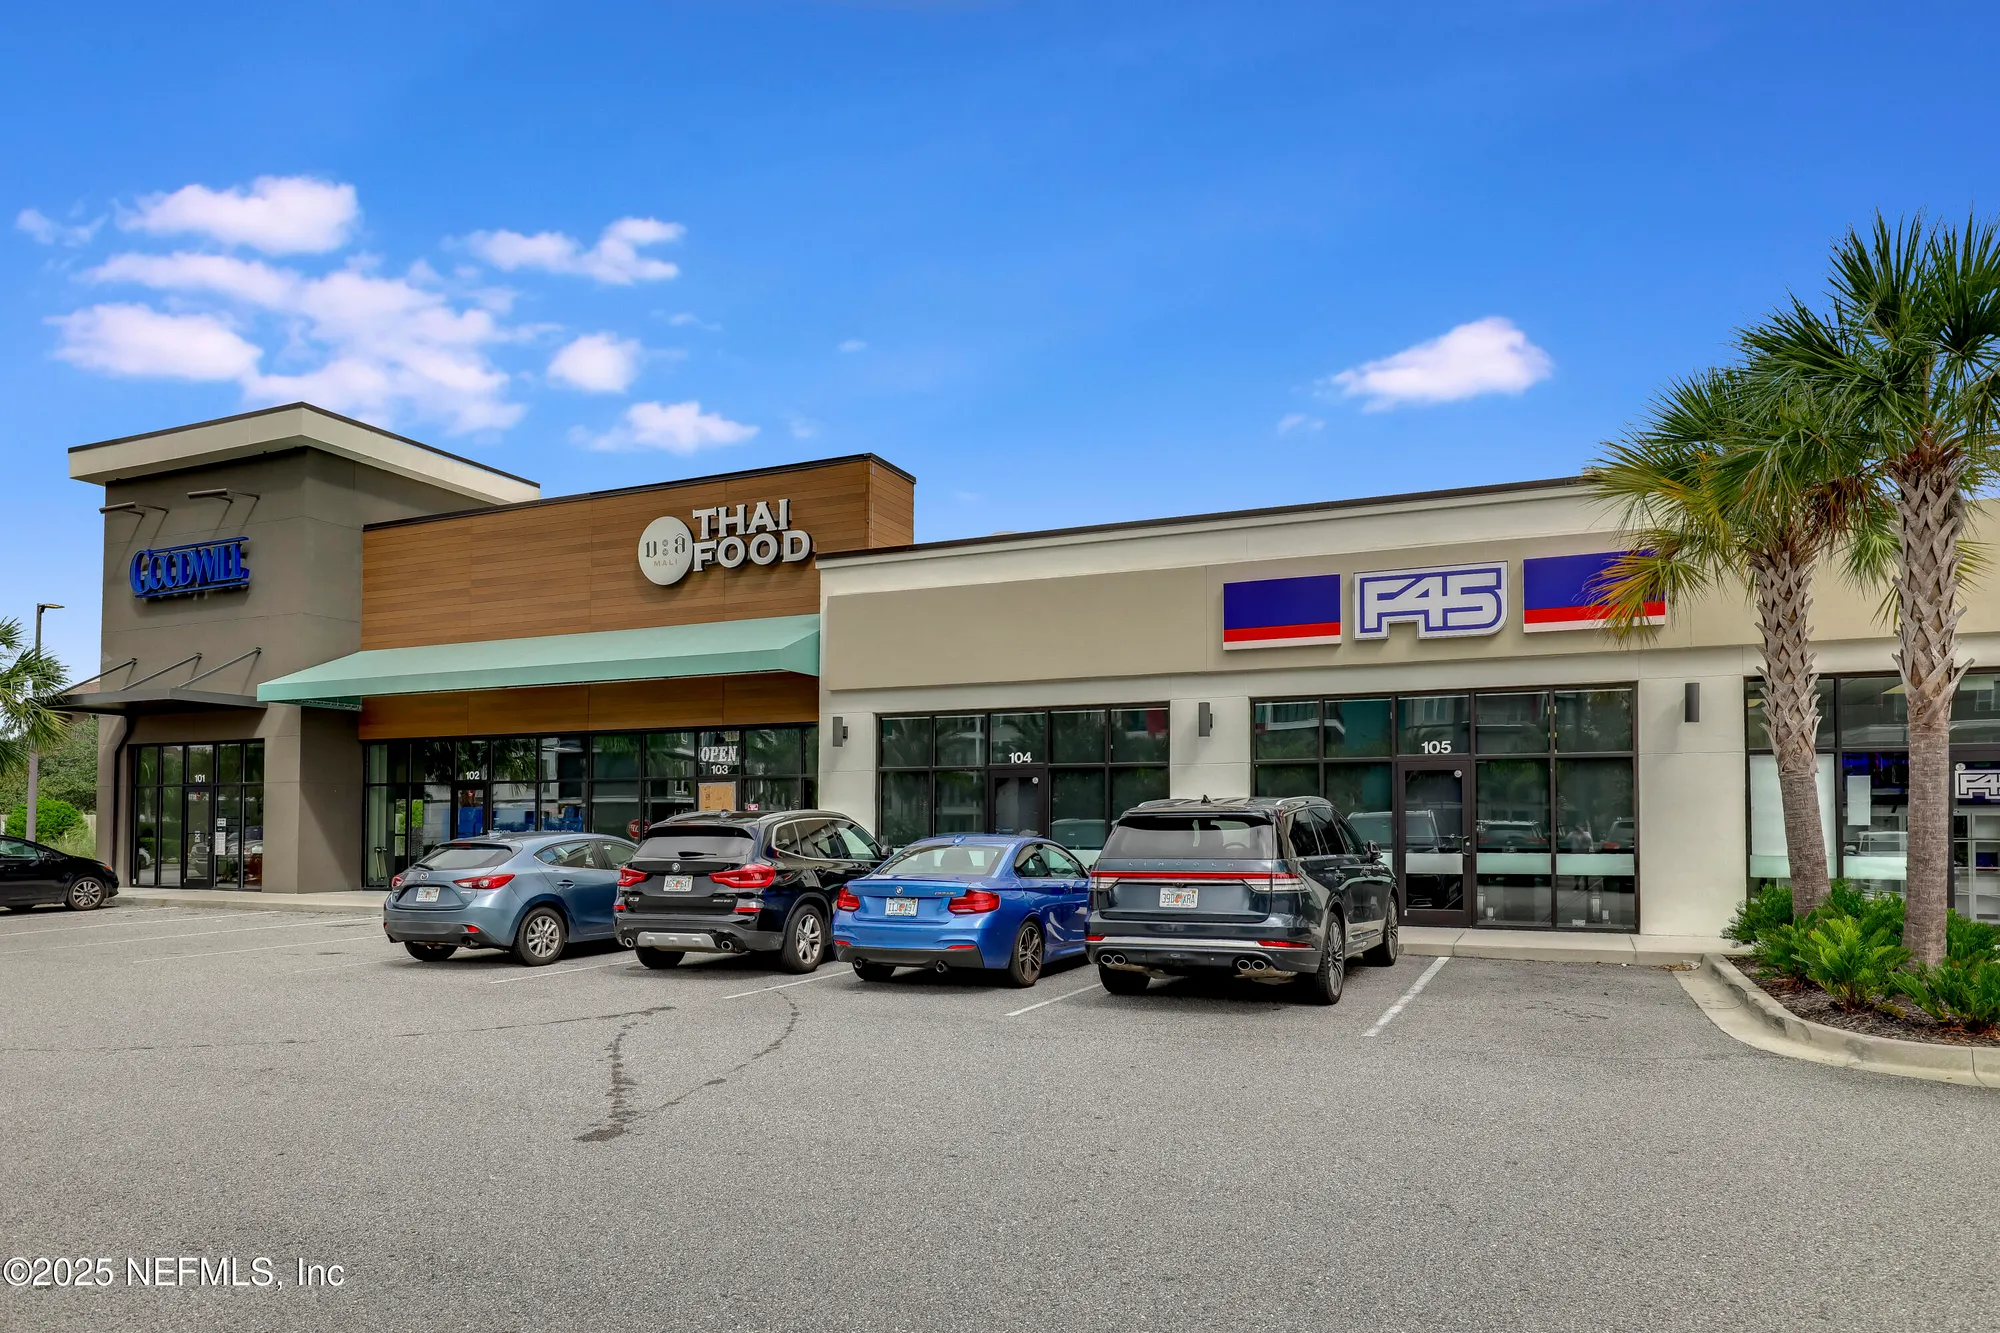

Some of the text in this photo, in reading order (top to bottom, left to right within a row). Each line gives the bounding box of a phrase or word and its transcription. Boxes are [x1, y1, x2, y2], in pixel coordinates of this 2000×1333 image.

[692, 498, 790, 540] THAI
[692, 529, 811, 572] FOOD
[129, 543, 250, 595] GOODWILL
[653, 559, 678, 568] MALI
[1360, 568, 1501, 633] F45
[700, 745, 738, 762] OPEN
[1421, 740, 1452, 754] 105
[1008, 751, 1032, 764] 104
[465, 771, 480, 780] 102
[711, 765, 729, 775] 103
[194, 774, 206, 783] 101
[1959, 773, 2000, 796] F4
